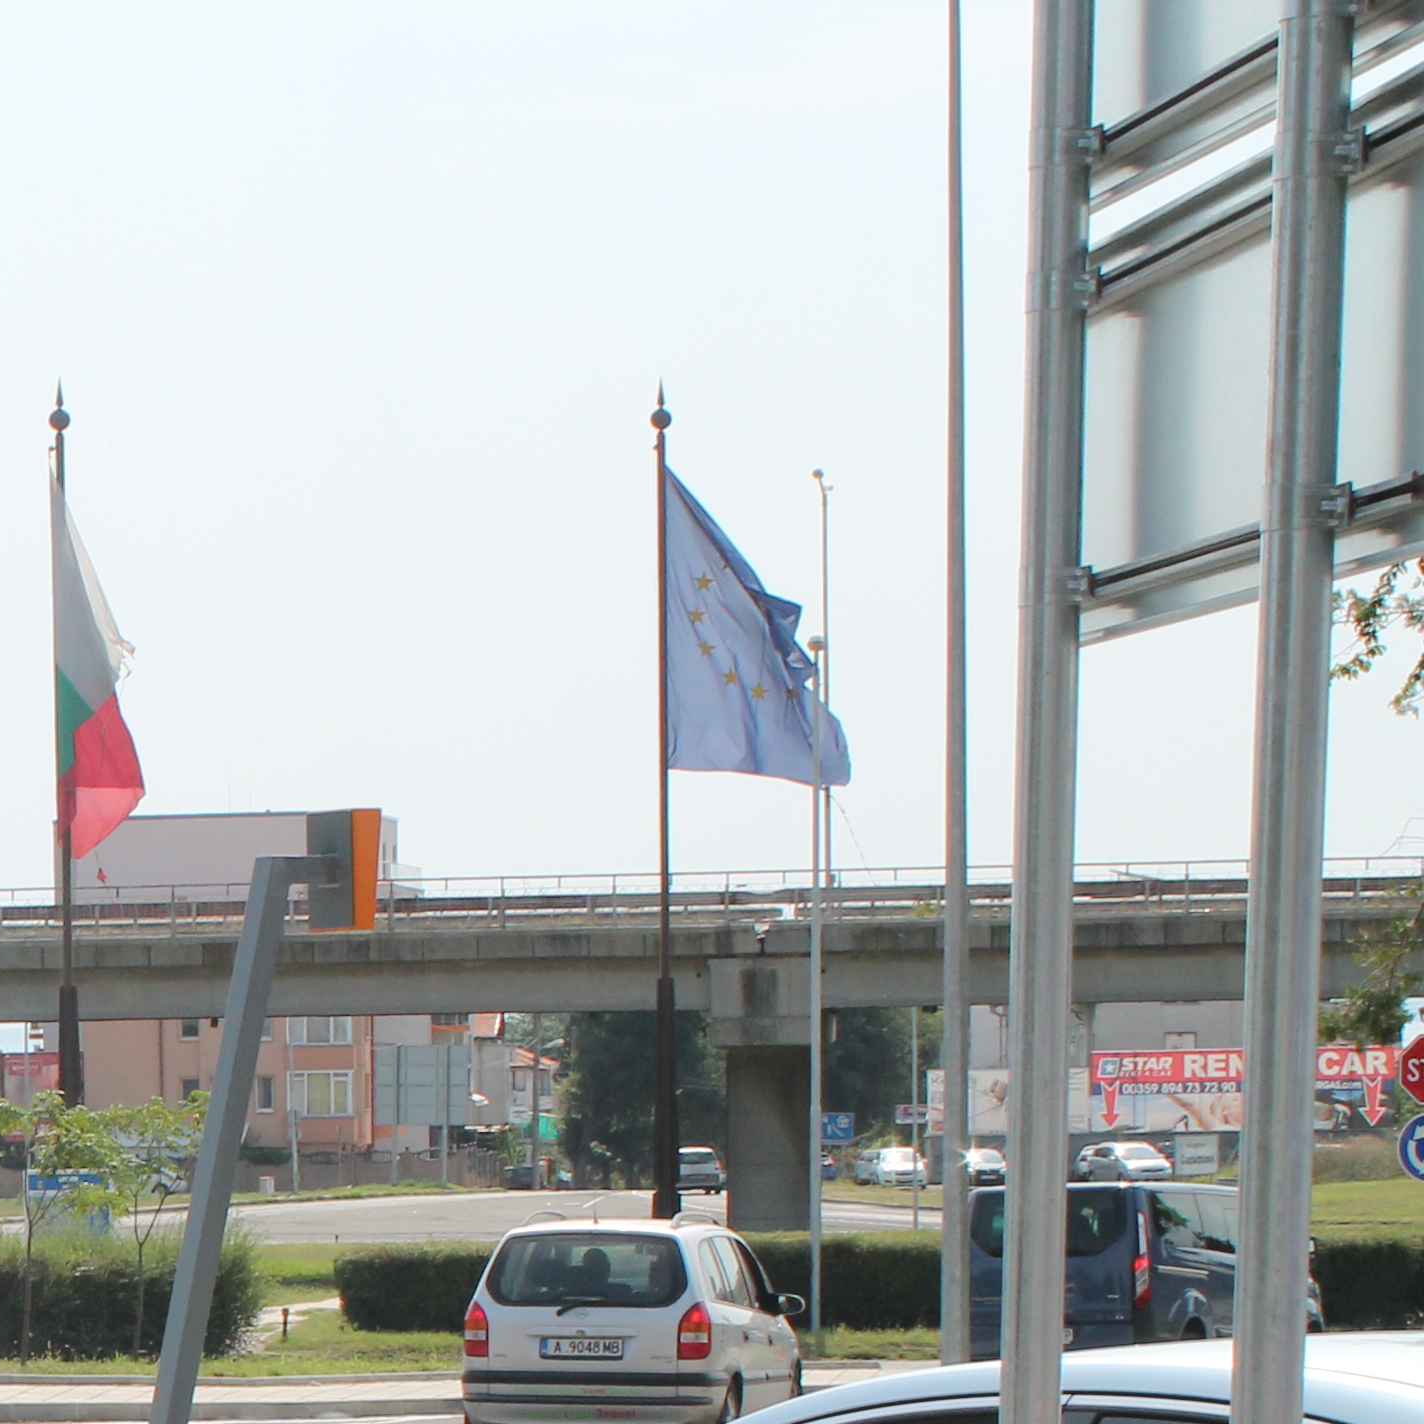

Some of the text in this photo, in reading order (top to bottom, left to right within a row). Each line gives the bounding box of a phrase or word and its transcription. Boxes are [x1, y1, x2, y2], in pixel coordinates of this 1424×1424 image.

[1120, 1056, 1173, 1071] STAR
[1317, 1050, 1389, 1076] CAR
[1122, 1081, 1237, 1095] 00359 894 73 72 90
[554, 1341, 620, 1354] A 9048 MB
